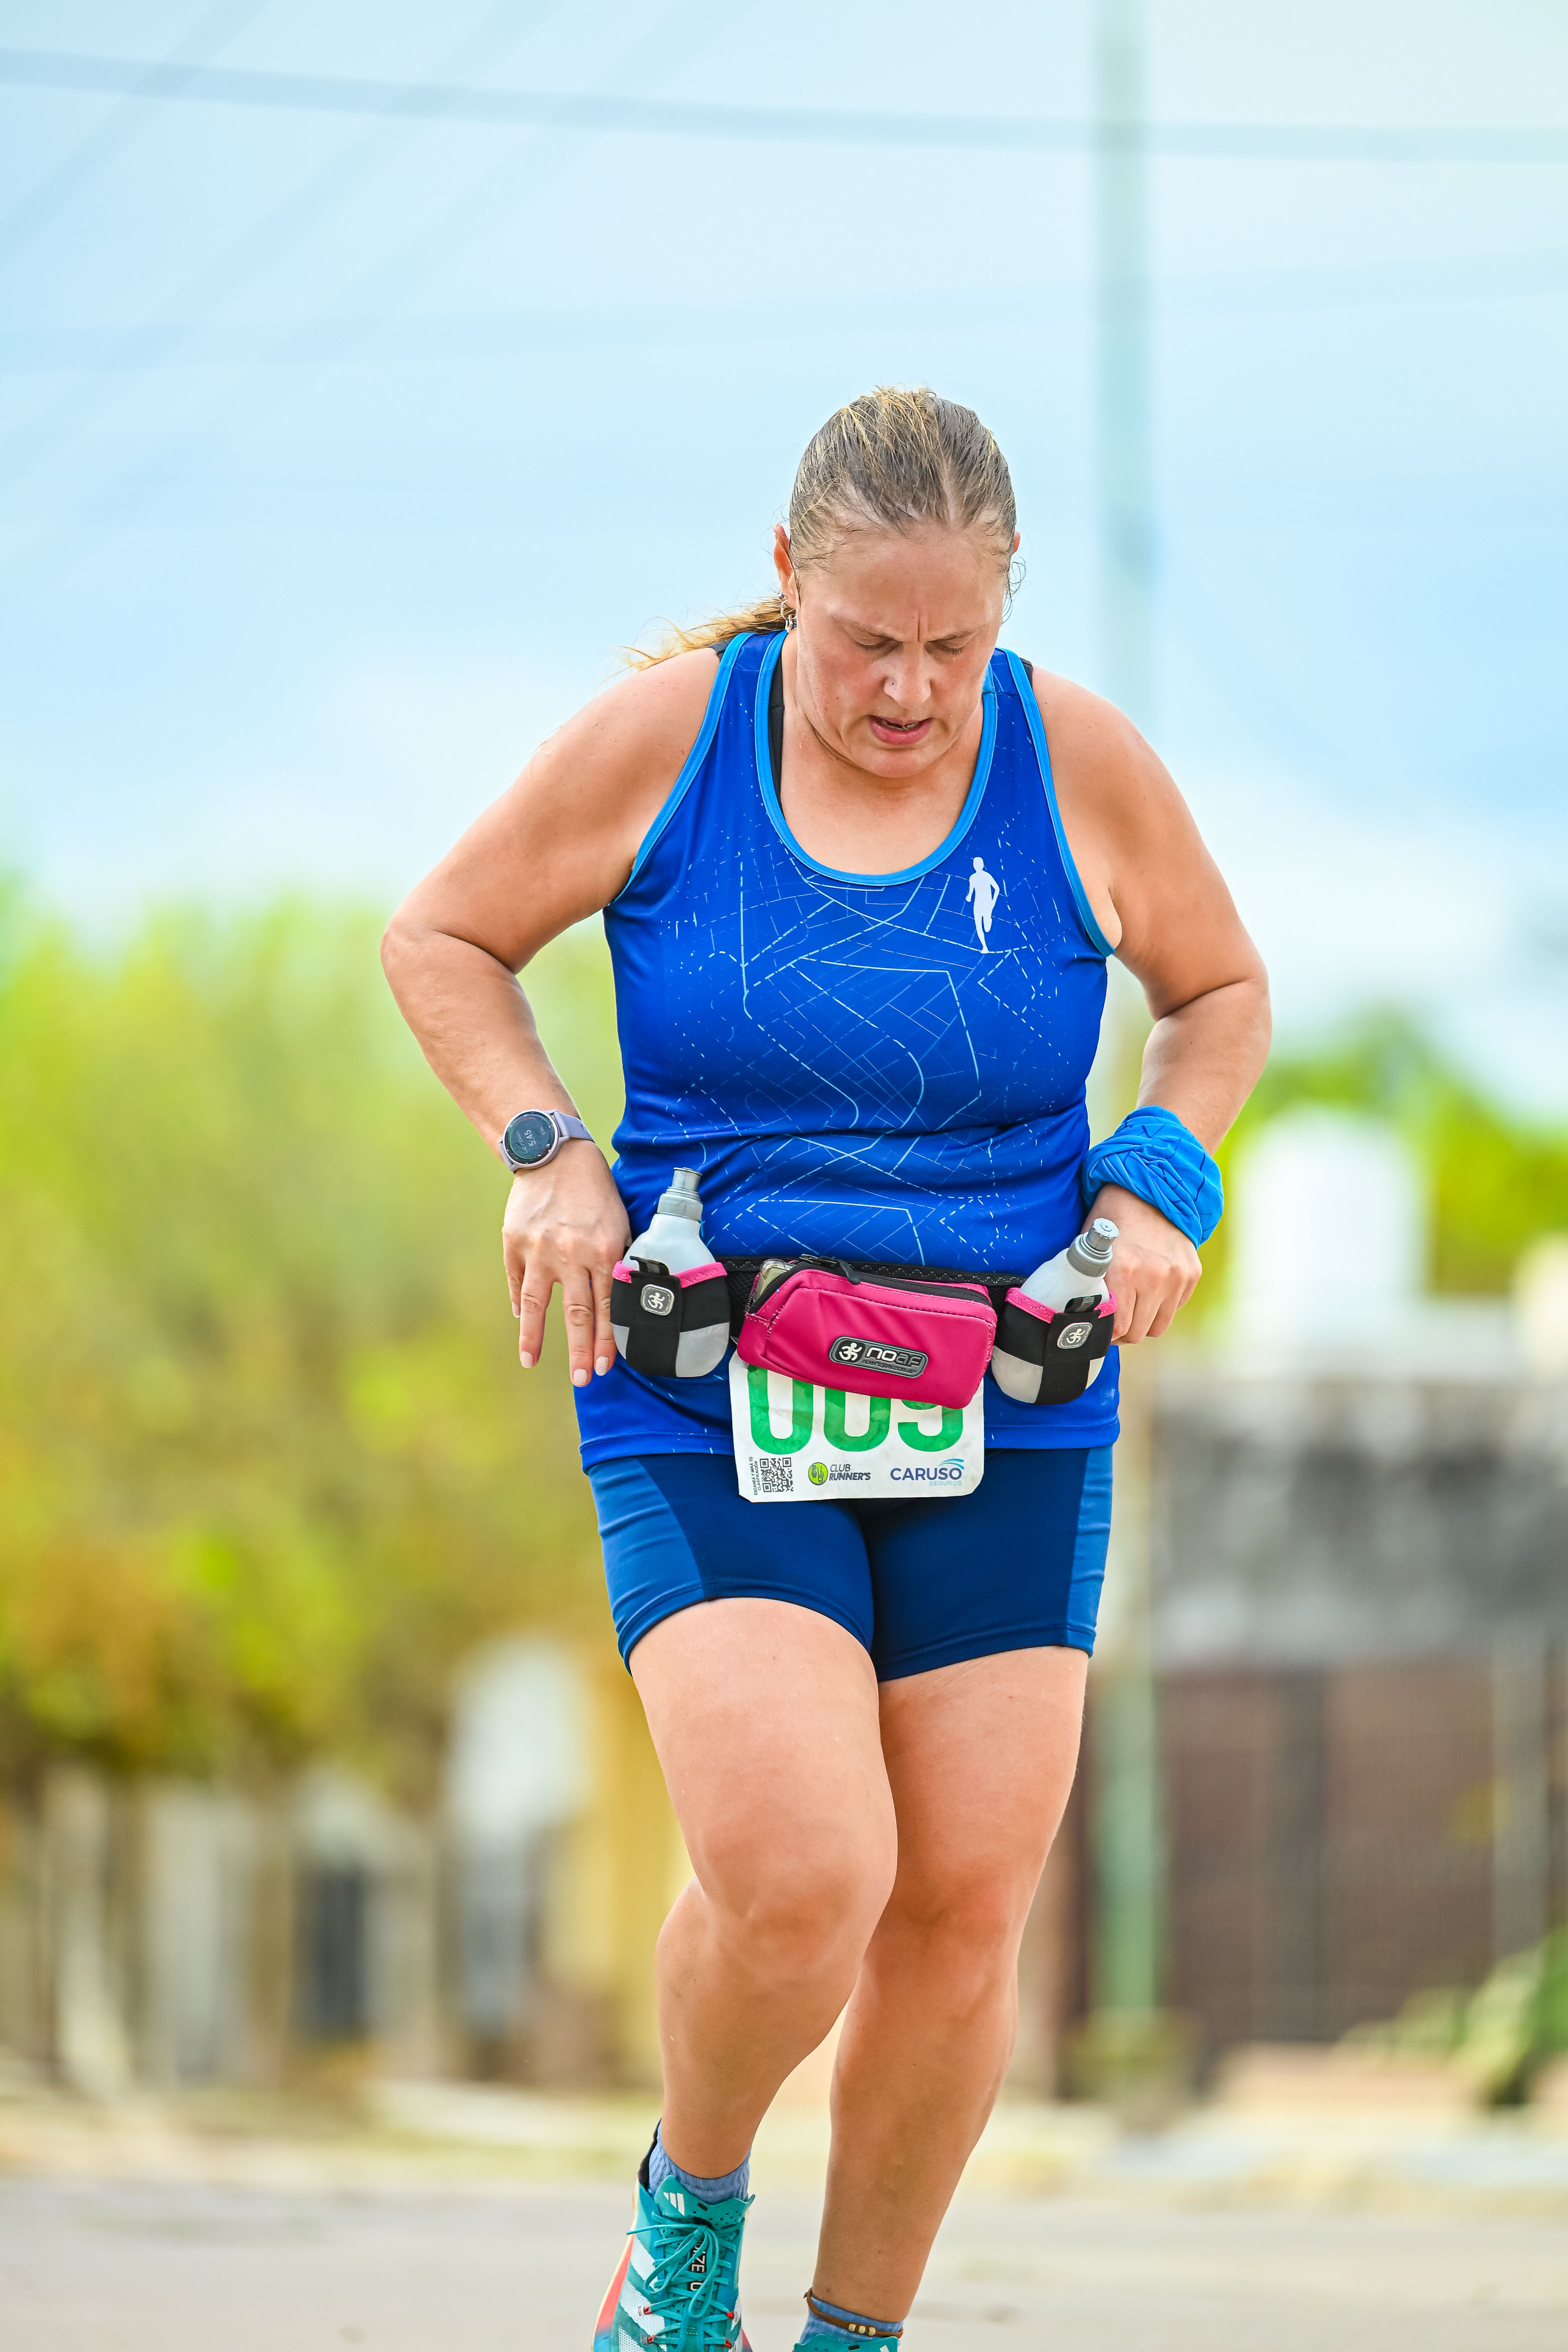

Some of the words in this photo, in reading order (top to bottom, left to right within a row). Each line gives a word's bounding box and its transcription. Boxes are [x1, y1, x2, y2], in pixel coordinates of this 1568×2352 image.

[866, 1347, 922, 1367] noaf
[830, 1464, 851, 1472] CLUB
[829, 1472, 872, 1481] RUNNER'S
[890, 1468, 962, 1481] CARUSO
